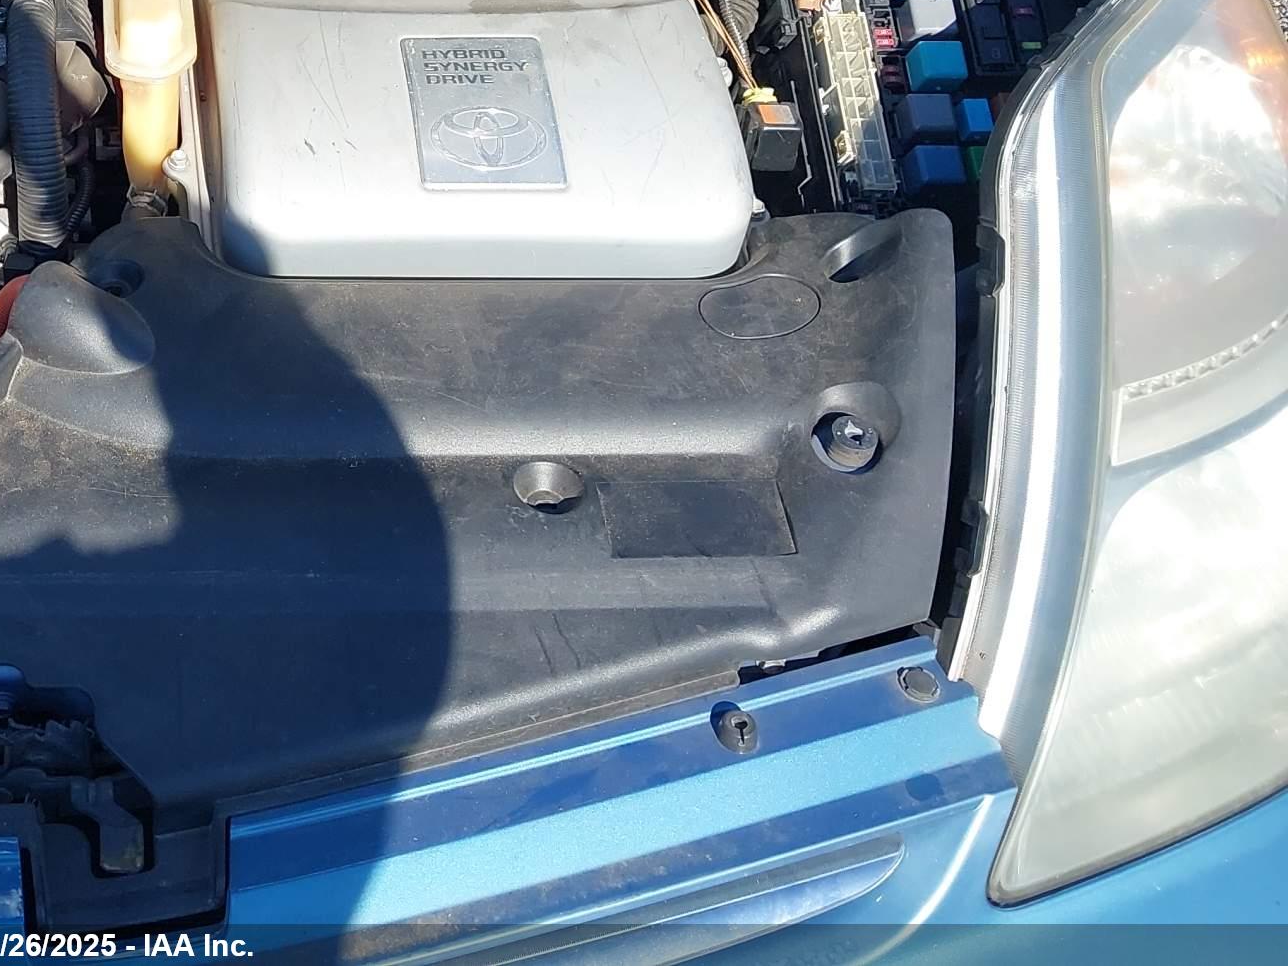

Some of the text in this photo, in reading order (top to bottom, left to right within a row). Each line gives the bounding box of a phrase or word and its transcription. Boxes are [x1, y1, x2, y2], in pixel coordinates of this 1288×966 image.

[422, 49, 506, 59] HYBRID
[423, 61, 528, 72] SYNERGY
[425, 74, 494, 84] DRIVE
